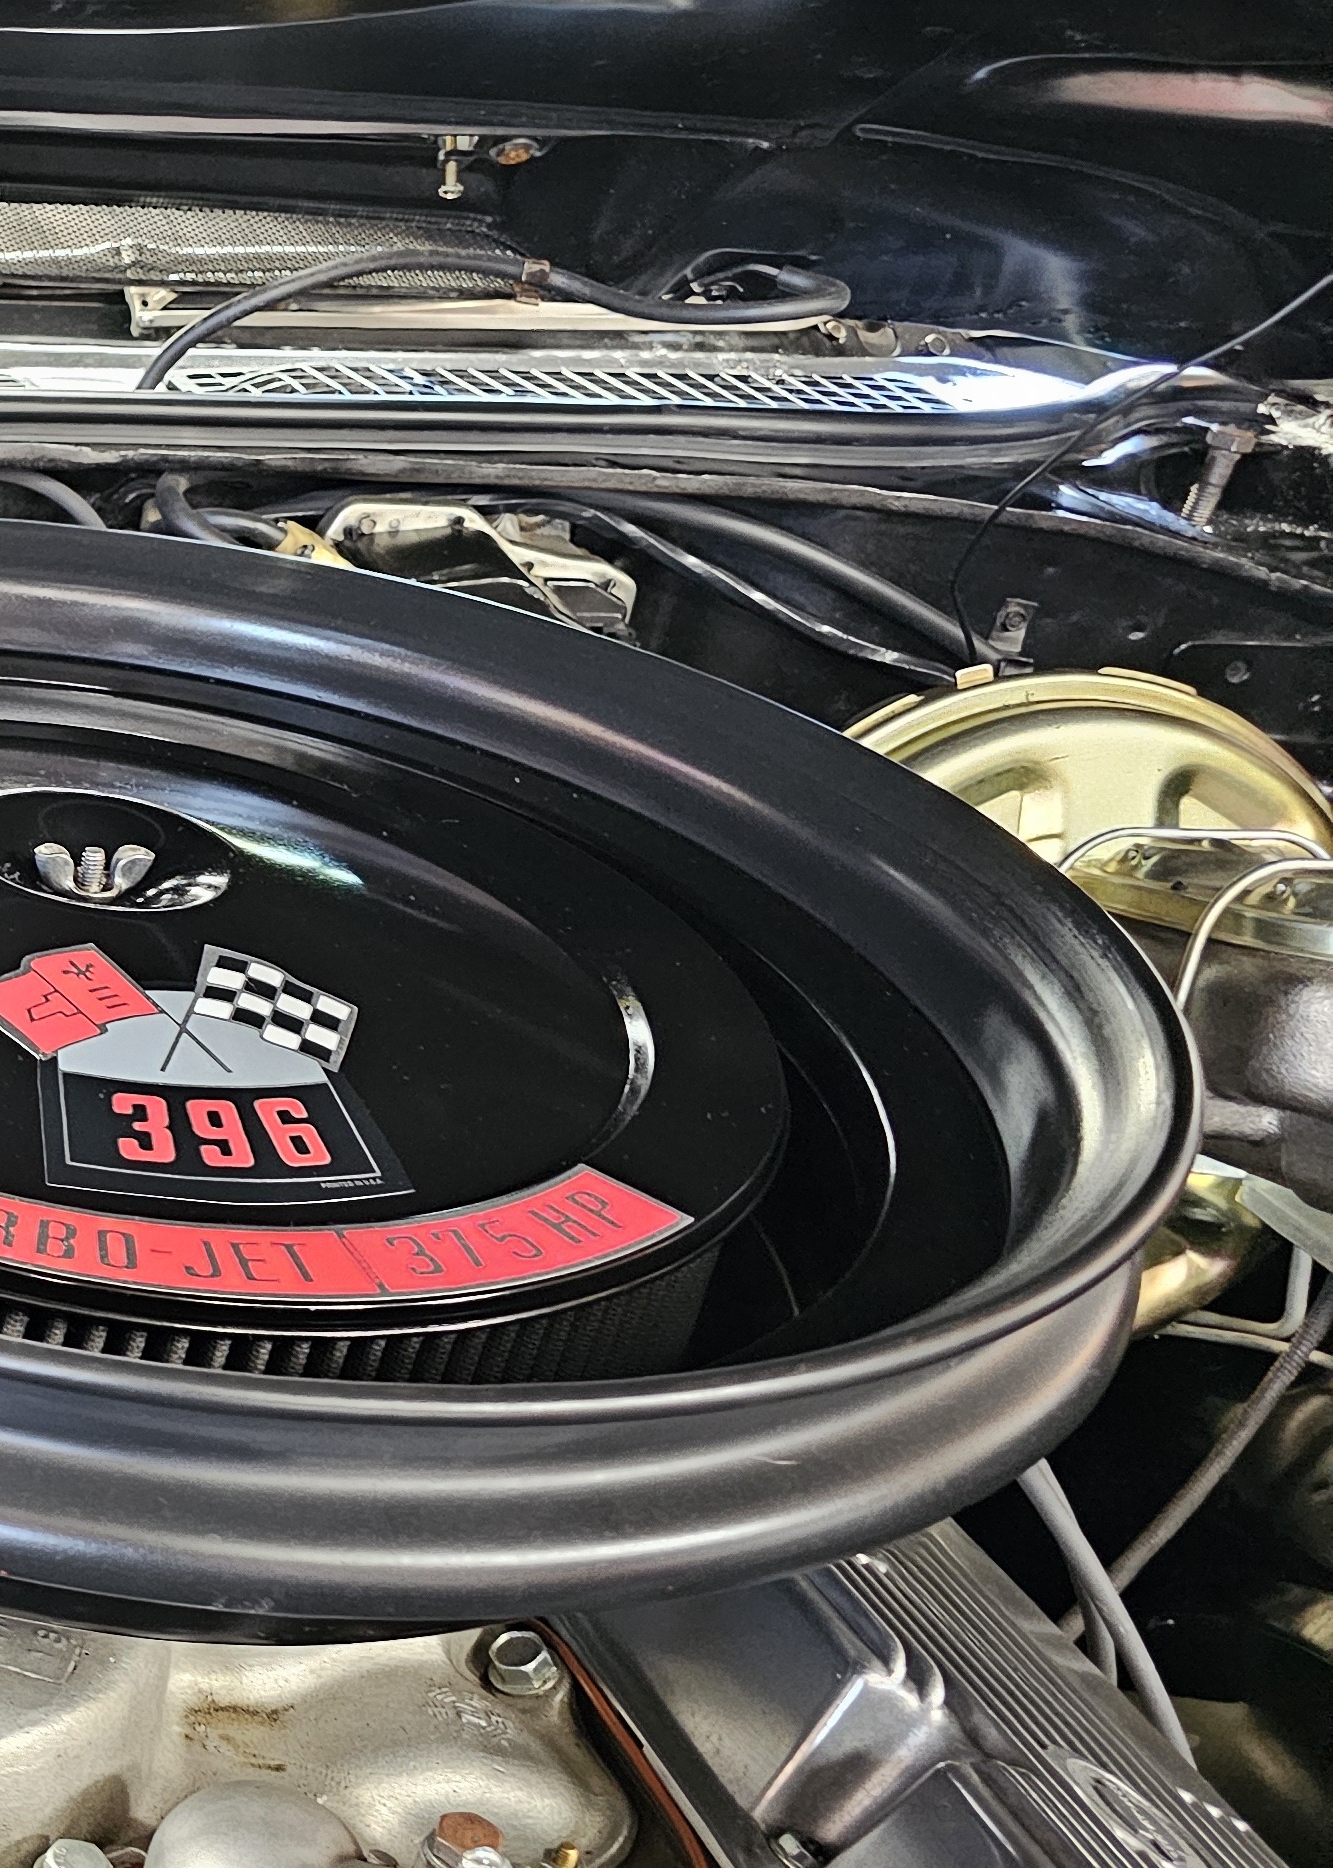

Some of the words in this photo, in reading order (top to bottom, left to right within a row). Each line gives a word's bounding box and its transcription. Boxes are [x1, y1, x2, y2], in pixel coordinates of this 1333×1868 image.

[111, 1092, 331, 1168] 396
[386, 1219, 544, 1275] 375
[527, 1191, 622, 1245] HP
